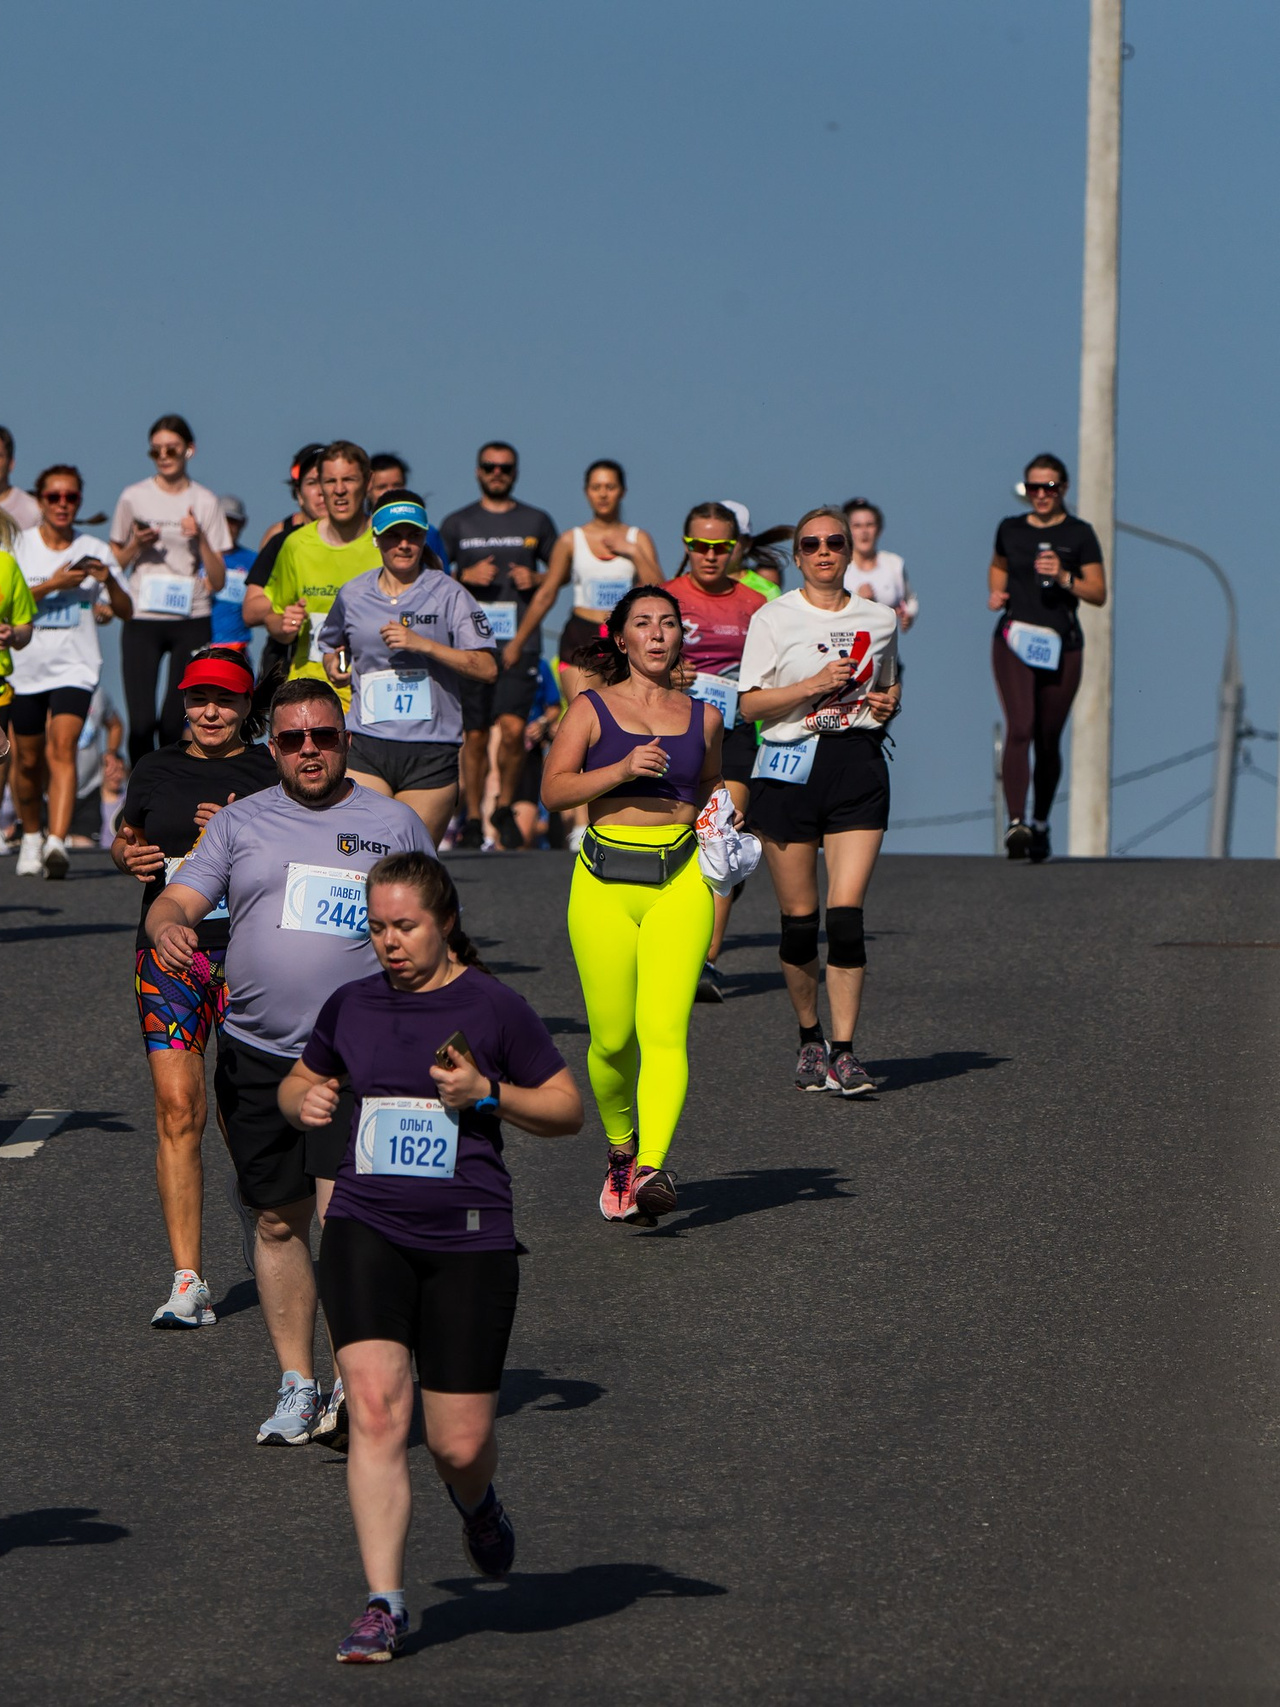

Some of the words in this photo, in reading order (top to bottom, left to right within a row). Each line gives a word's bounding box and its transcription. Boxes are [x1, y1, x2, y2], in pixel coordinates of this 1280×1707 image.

[394, 694, 413, 713] 47
[769, 751, 802, 775] 417
[330, 885, 361, 901] ПАВЕЛ
[315, 899, 368, 933] 2442
[400, 1118, 433, 1132] ОЛЬГА
[389, 1135, 448, 1168] 1622
